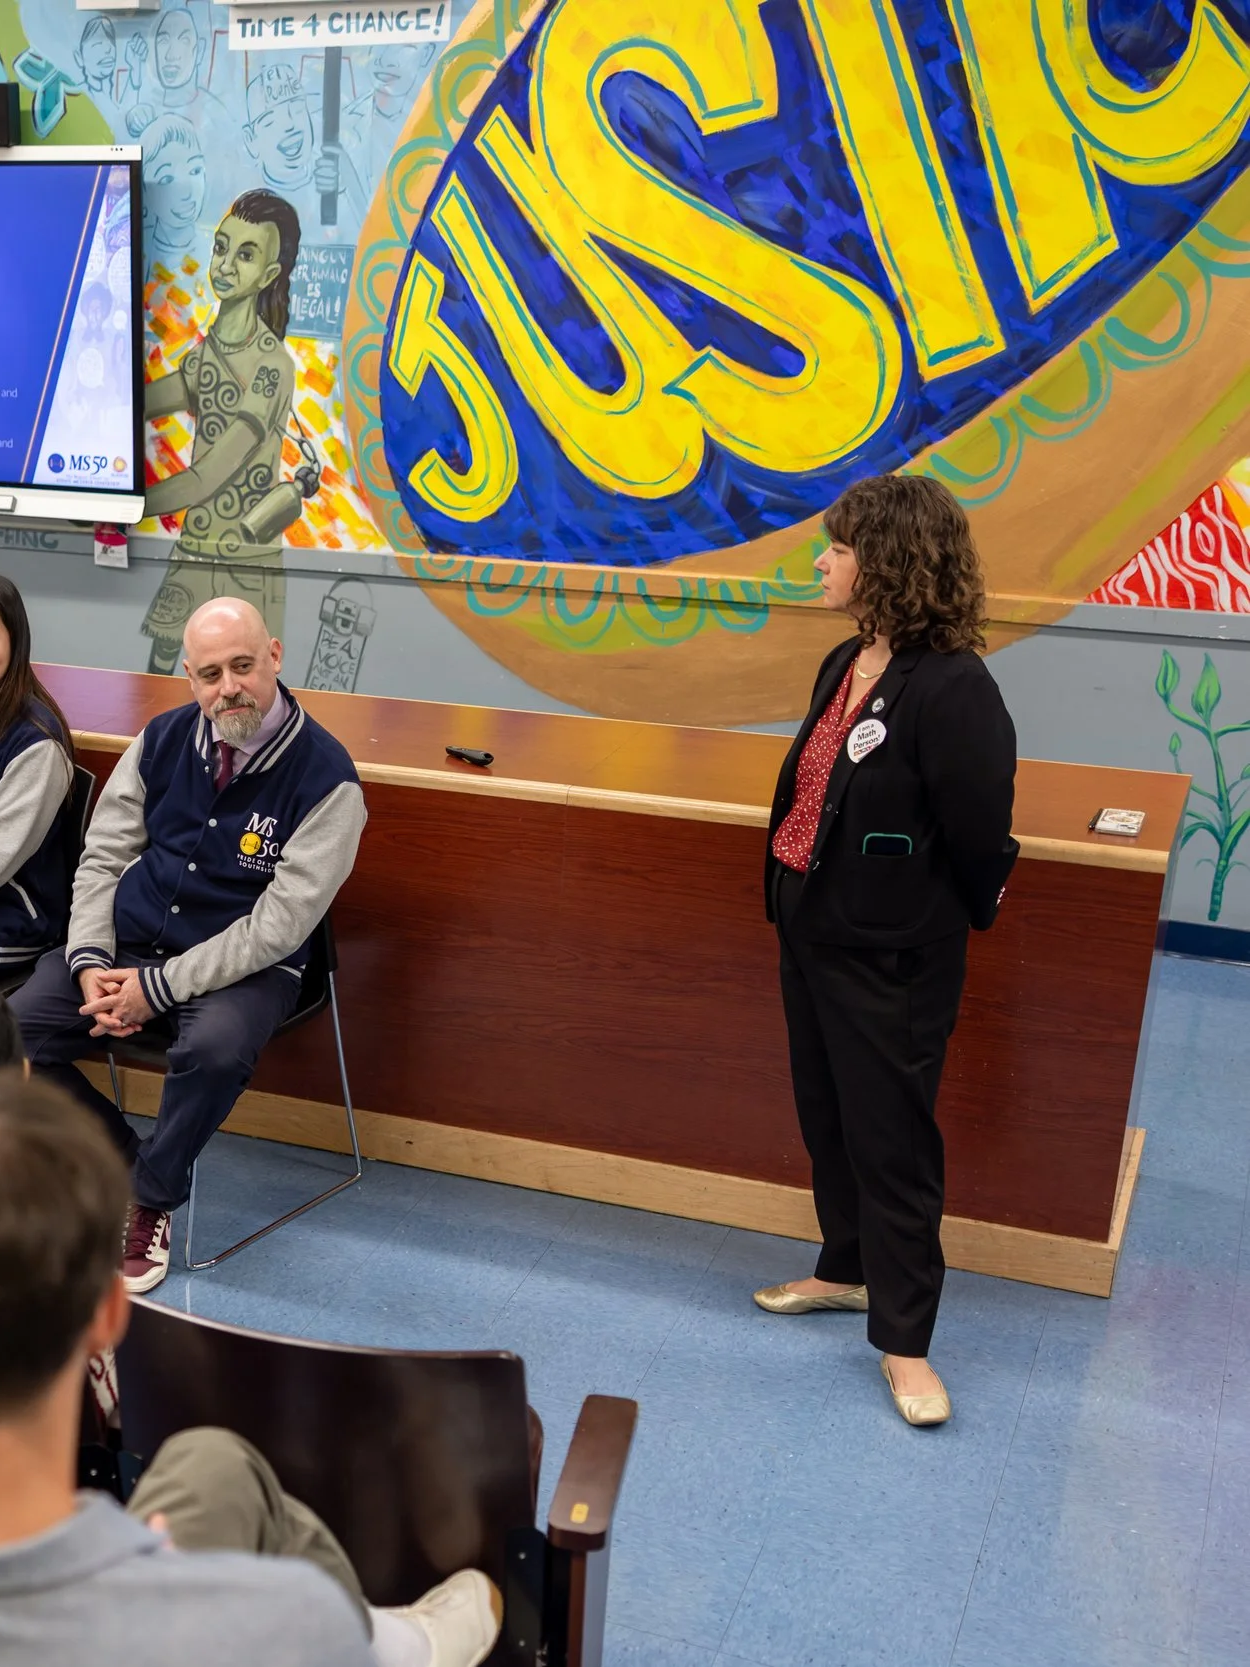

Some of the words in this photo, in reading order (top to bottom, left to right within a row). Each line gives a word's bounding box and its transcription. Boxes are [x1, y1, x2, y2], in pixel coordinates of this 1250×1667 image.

[301, 13, 321, 37] 4
[327, 4, 446, 37] CHANGE!
[307, 283, 321, 298] ES
[1, 387, 18, 398] and
[318, 647, 356, 675] VOICE
[853, 734, 881, 751] Person!
[857, 729, 877, 741] Math
[244, 812, 279, 838] MS
[256, 840, 279, 858] 50
[237, 853, 256, 863] PRIDE
